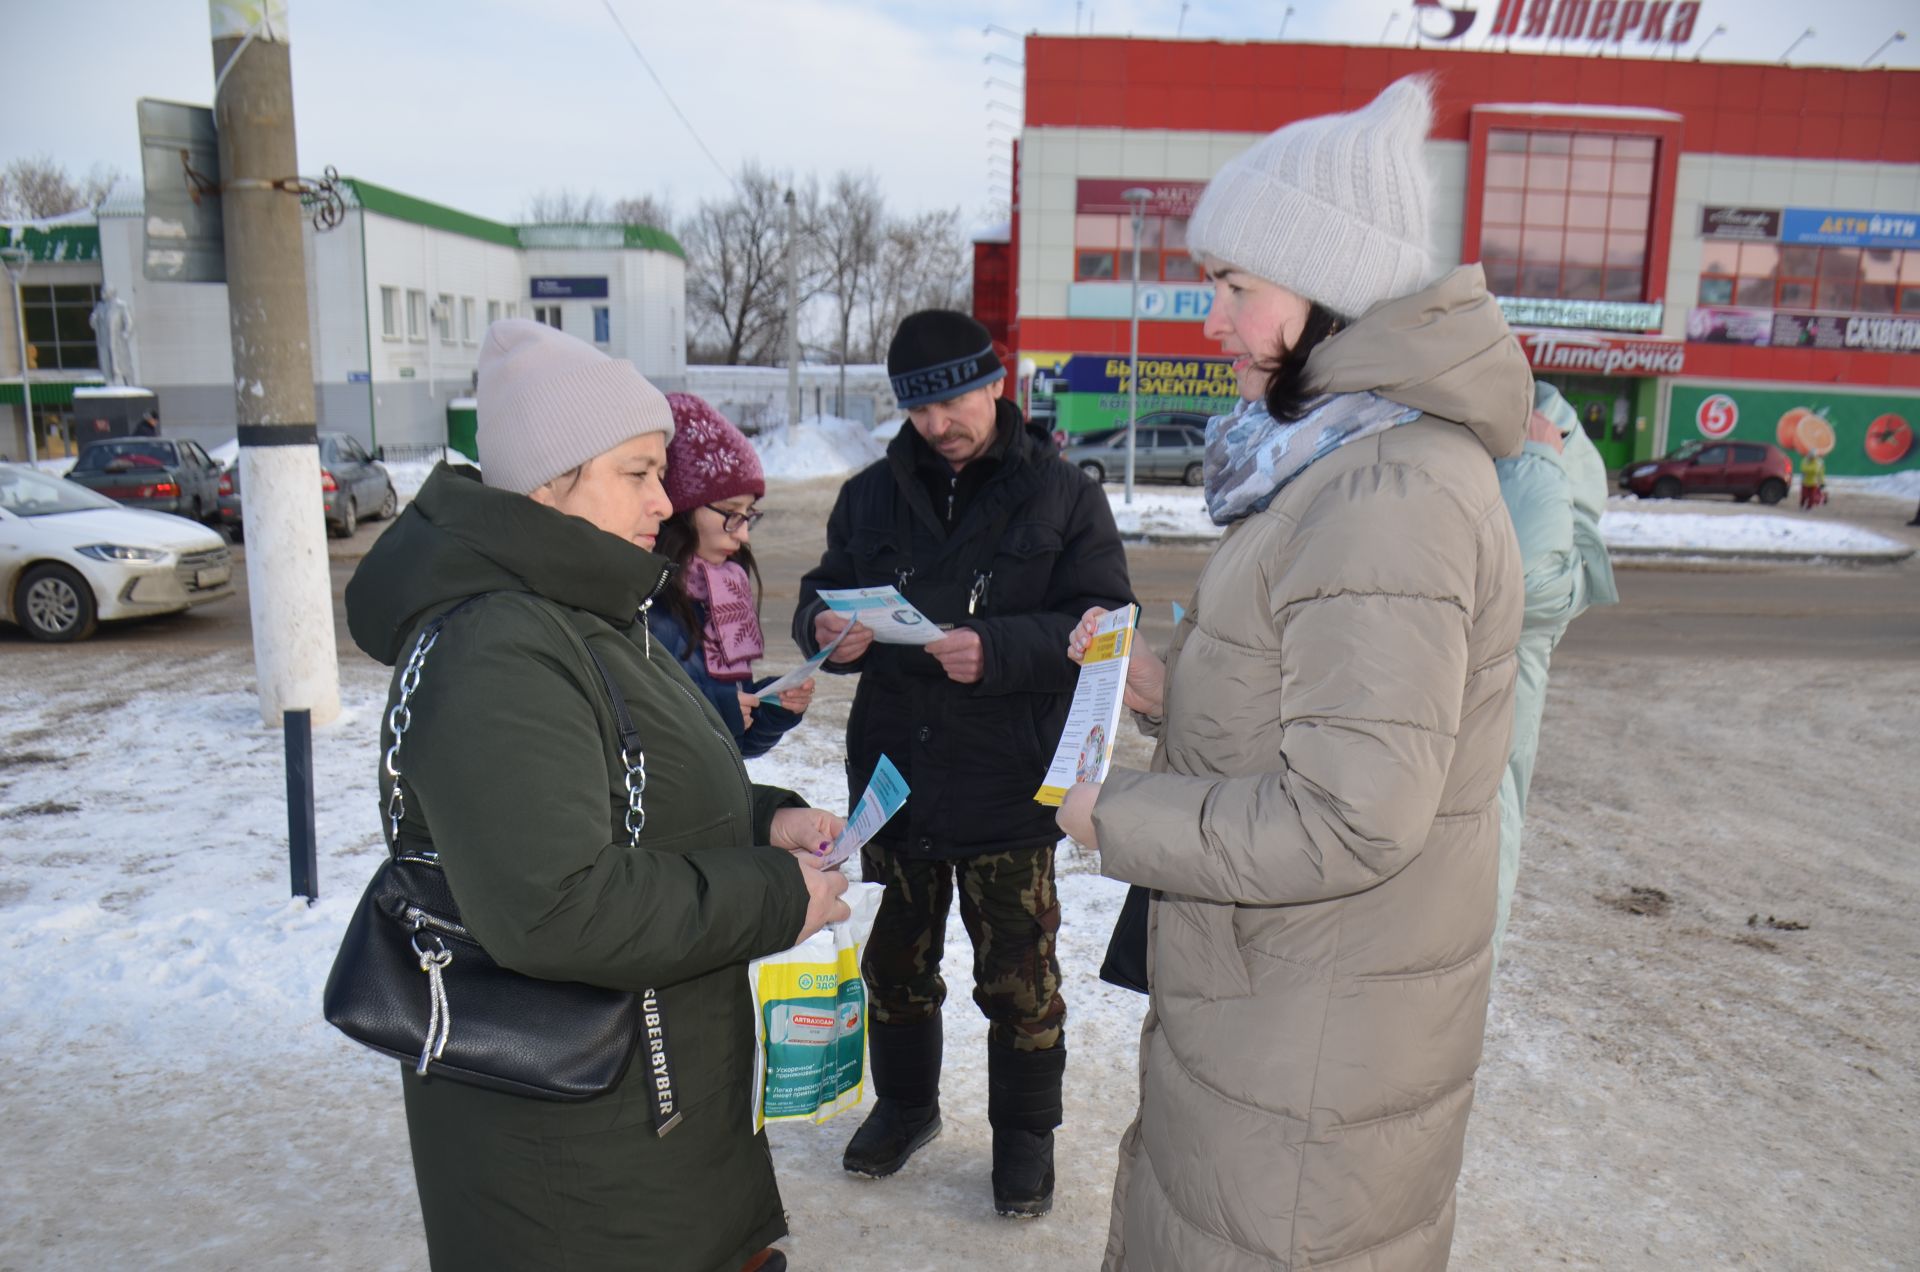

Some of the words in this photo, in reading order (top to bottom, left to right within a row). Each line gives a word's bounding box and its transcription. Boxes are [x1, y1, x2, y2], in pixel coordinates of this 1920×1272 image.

[893, 359, 979, 399] USSIA
[1105, 360, 1199, 379] БЫТОВАЯ
[1708, 402, 1728, 429] 5
